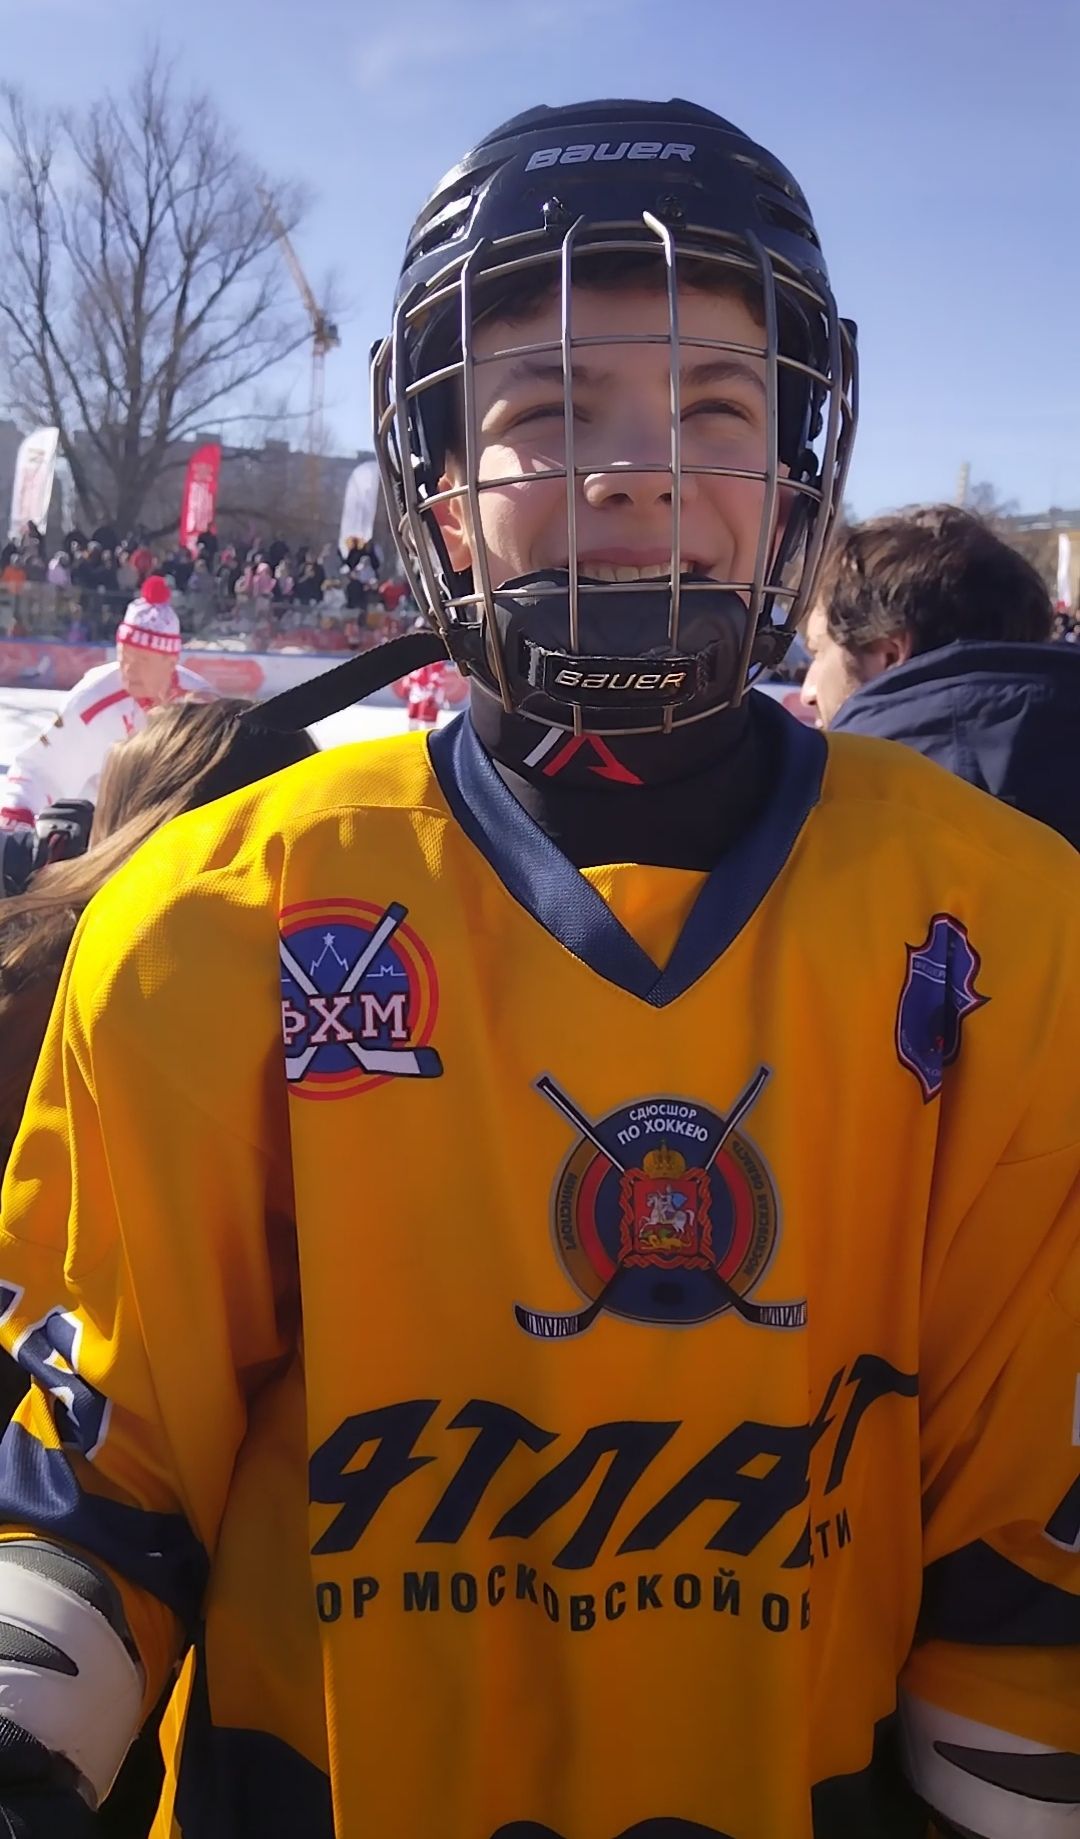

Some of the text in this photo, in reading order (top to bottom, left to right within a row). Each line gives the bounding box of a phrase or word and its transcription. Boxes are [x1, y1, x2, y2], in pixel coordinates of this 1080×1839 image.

[629, 1104, 697, 1121] СДЮСШОР
[617, 1118, 708, 1145] ПО ХОККЕЮ
[403, 1562, 740, 1632] МОСКОВСКОЙ
